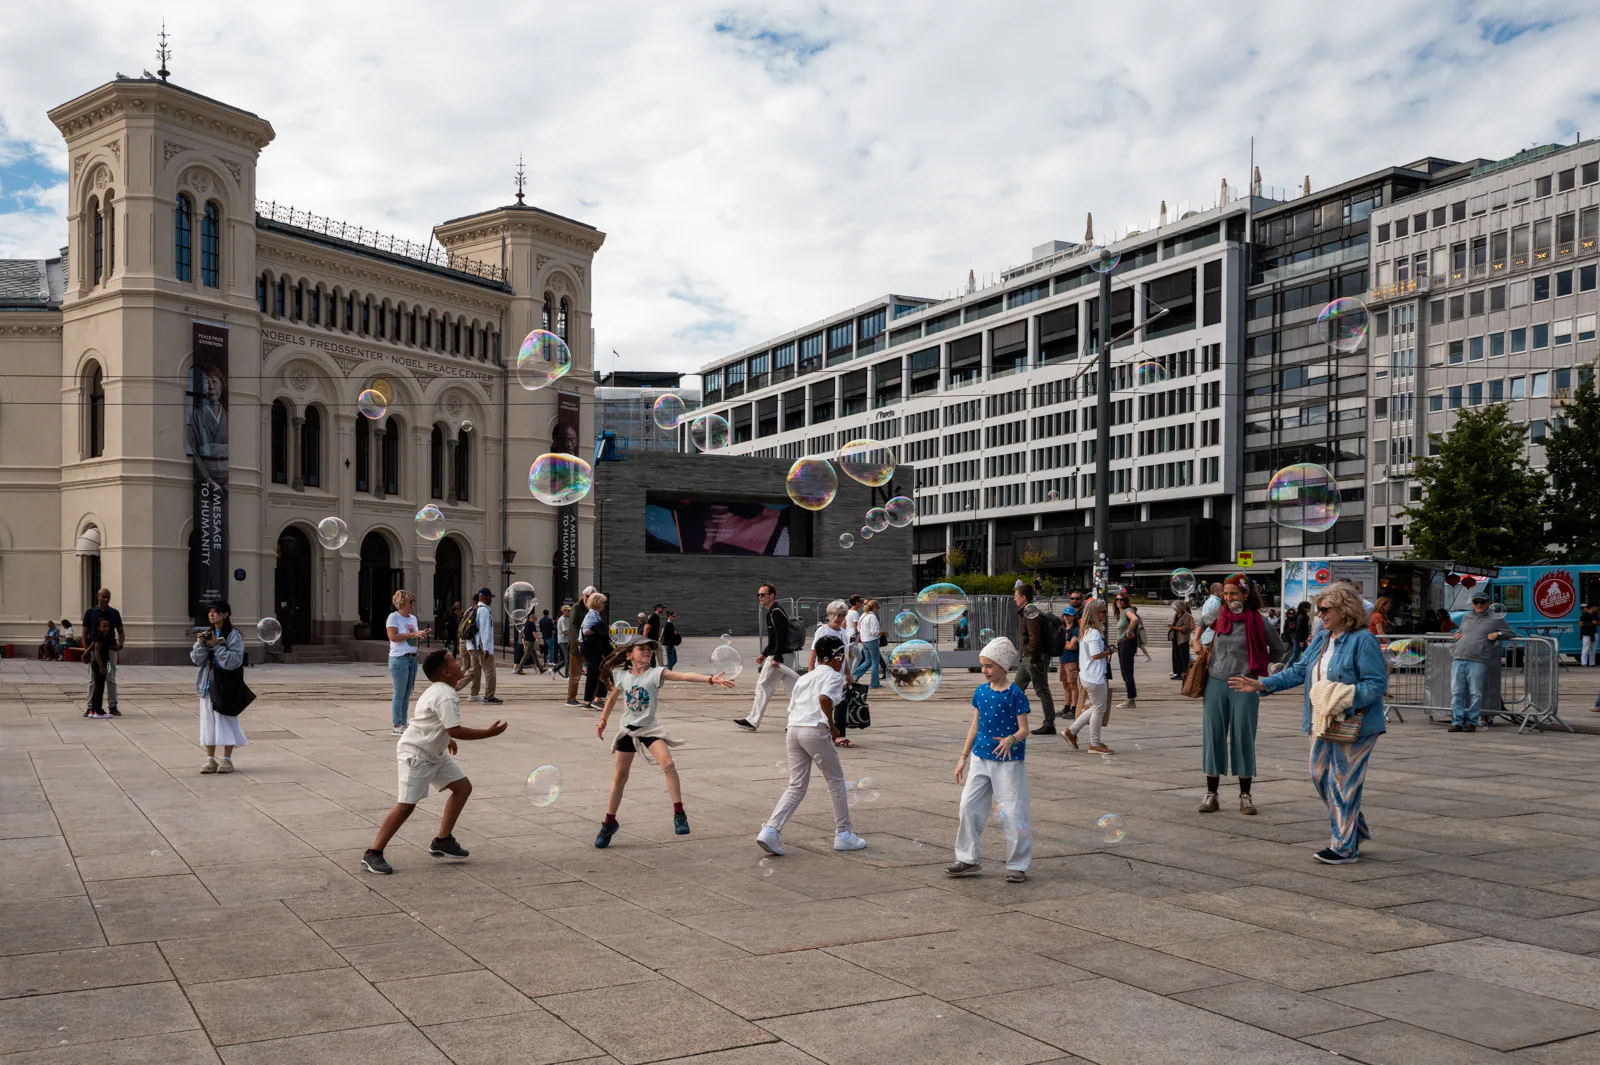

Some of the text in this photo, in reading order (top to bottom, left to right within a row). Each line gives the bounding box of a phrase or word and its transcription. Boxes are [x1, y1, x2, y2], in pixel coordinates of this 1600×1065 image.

[261, 328, 493, 383] NOBELS FREDSSENTER NOBEL PEACE CENTER
[201, 481, 211, 567] TO HUMANITY
[212, 482, 222, 550] A MESSAGE
[562, 515, 569, 527] TO
